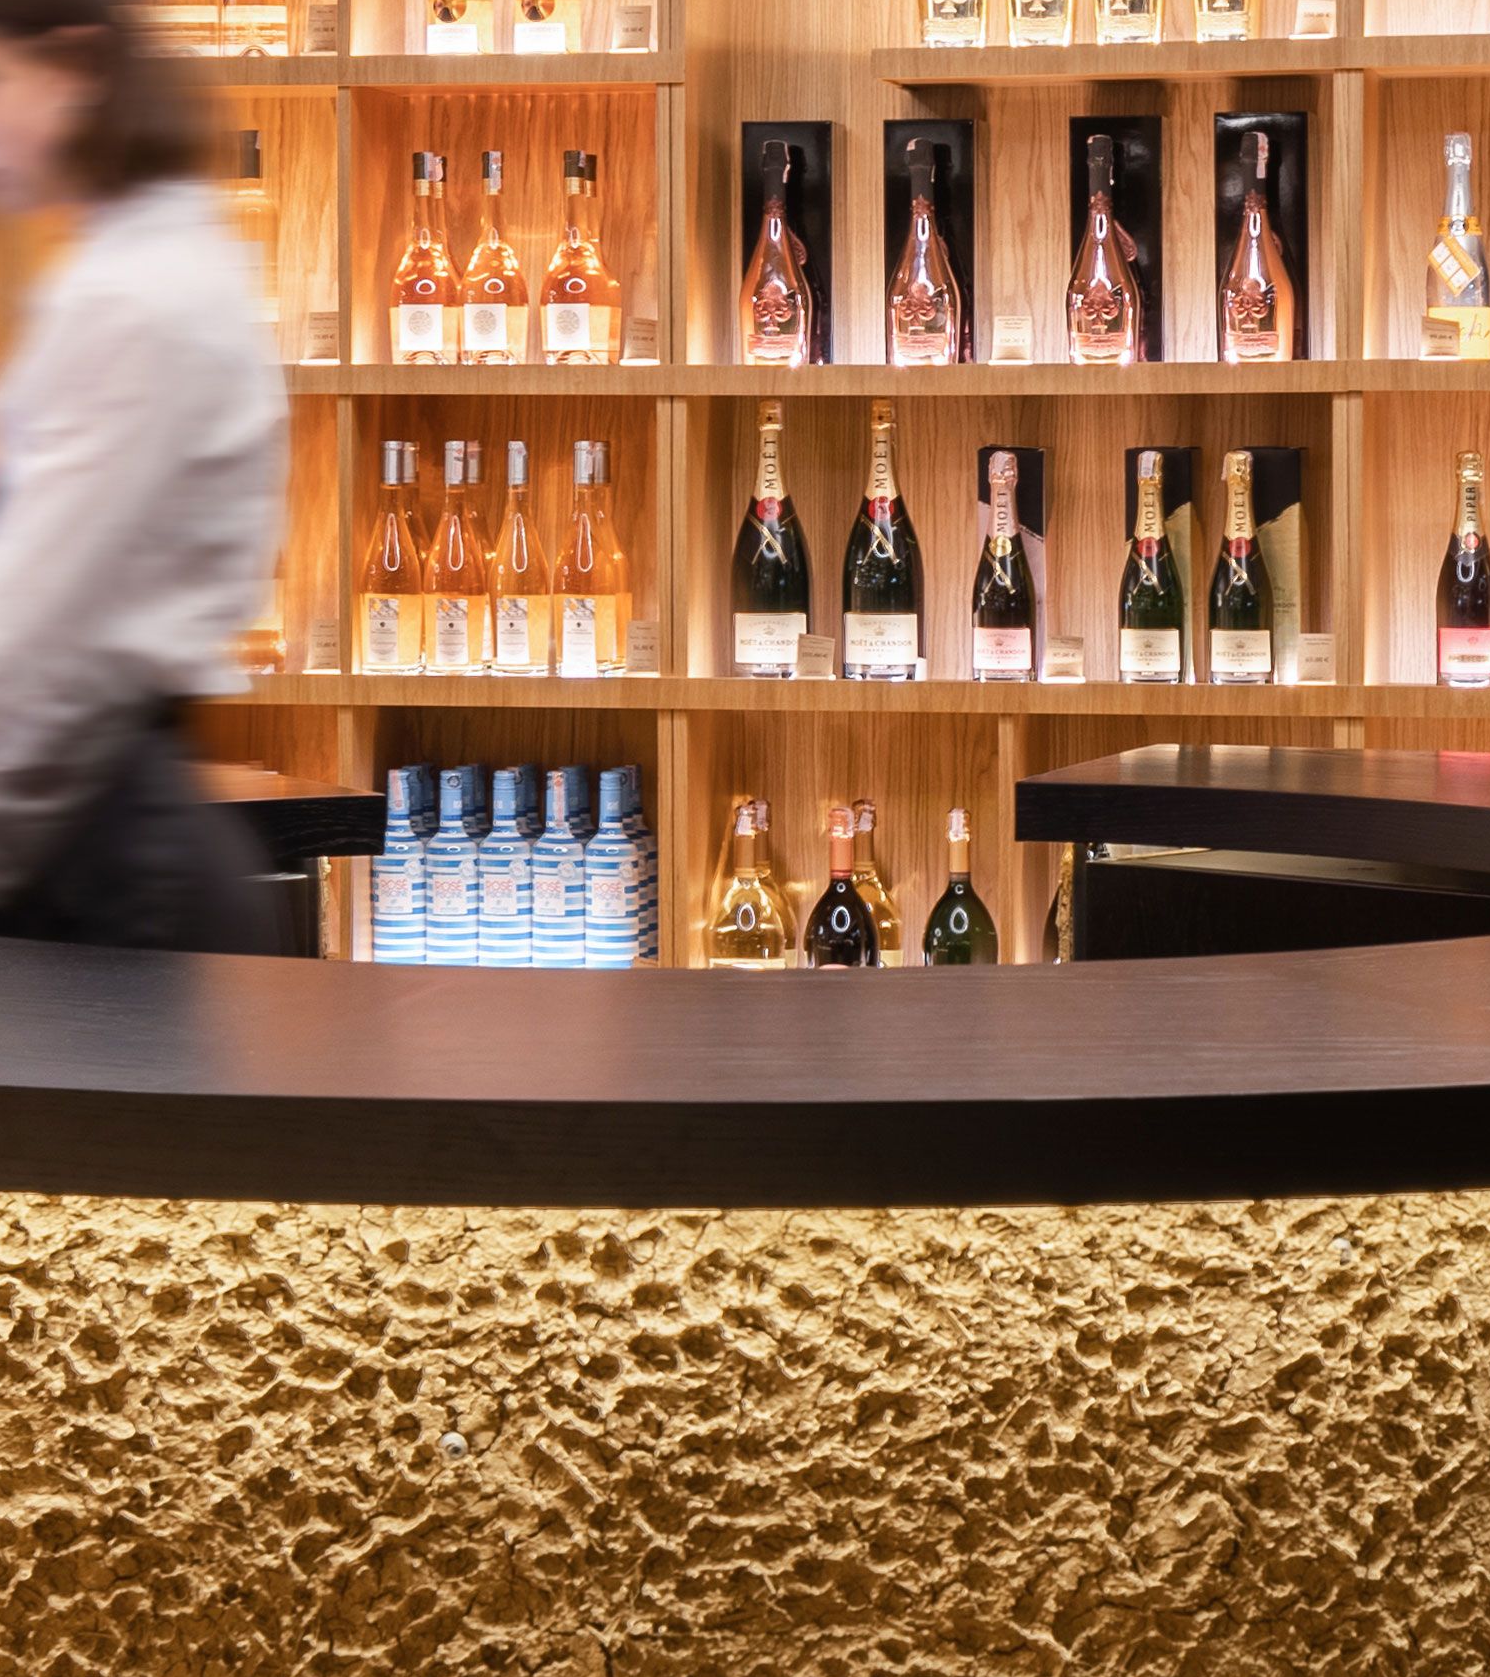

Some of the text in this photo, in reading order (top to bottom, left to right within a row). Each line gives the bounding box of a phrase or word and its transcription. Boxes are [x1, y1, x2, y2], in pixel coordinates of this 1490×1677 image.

[764, 438, 777, 490] MOËT
[874, 438, 887, 490] MOËT
[997, 490, 1007, 533] MOËT
[1144, 490, 1155, 533] MOËT
[1235, 490, 1246, 533] MOËT
[1466, 487, 1476, 521] PIPER
